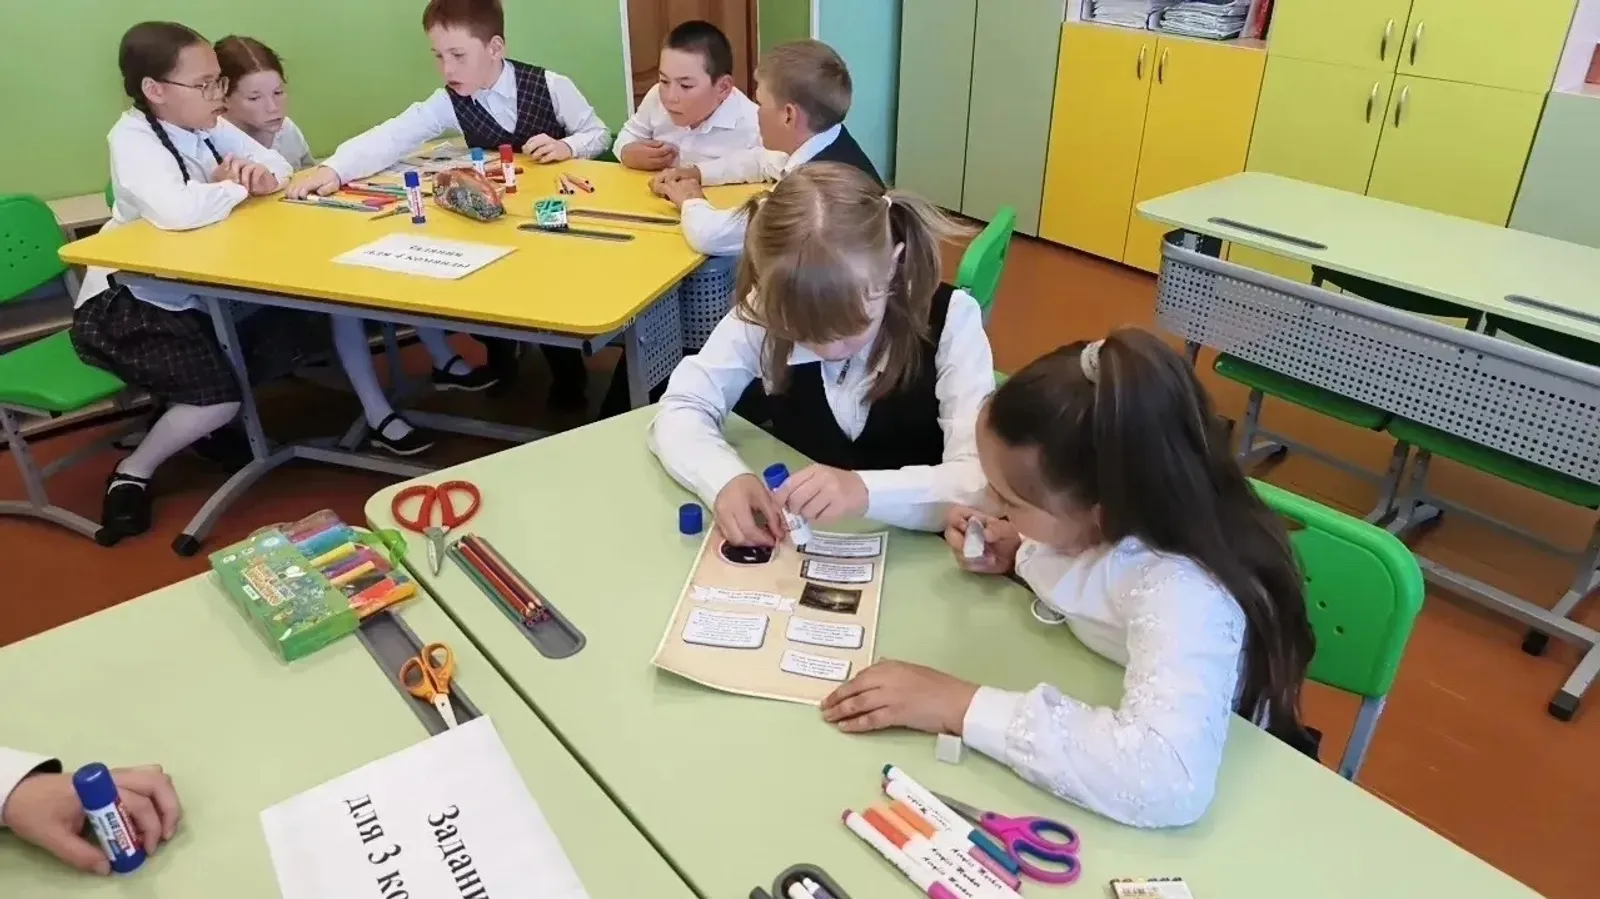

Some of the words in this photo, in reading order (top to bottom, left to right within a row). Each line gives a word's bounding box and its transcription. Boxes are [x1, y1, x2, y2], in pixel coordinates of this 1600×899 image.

[105, 811, 120, 830] GLUE
[342, 794, 385, 845] для
[367, 843, 402, 865] 3
